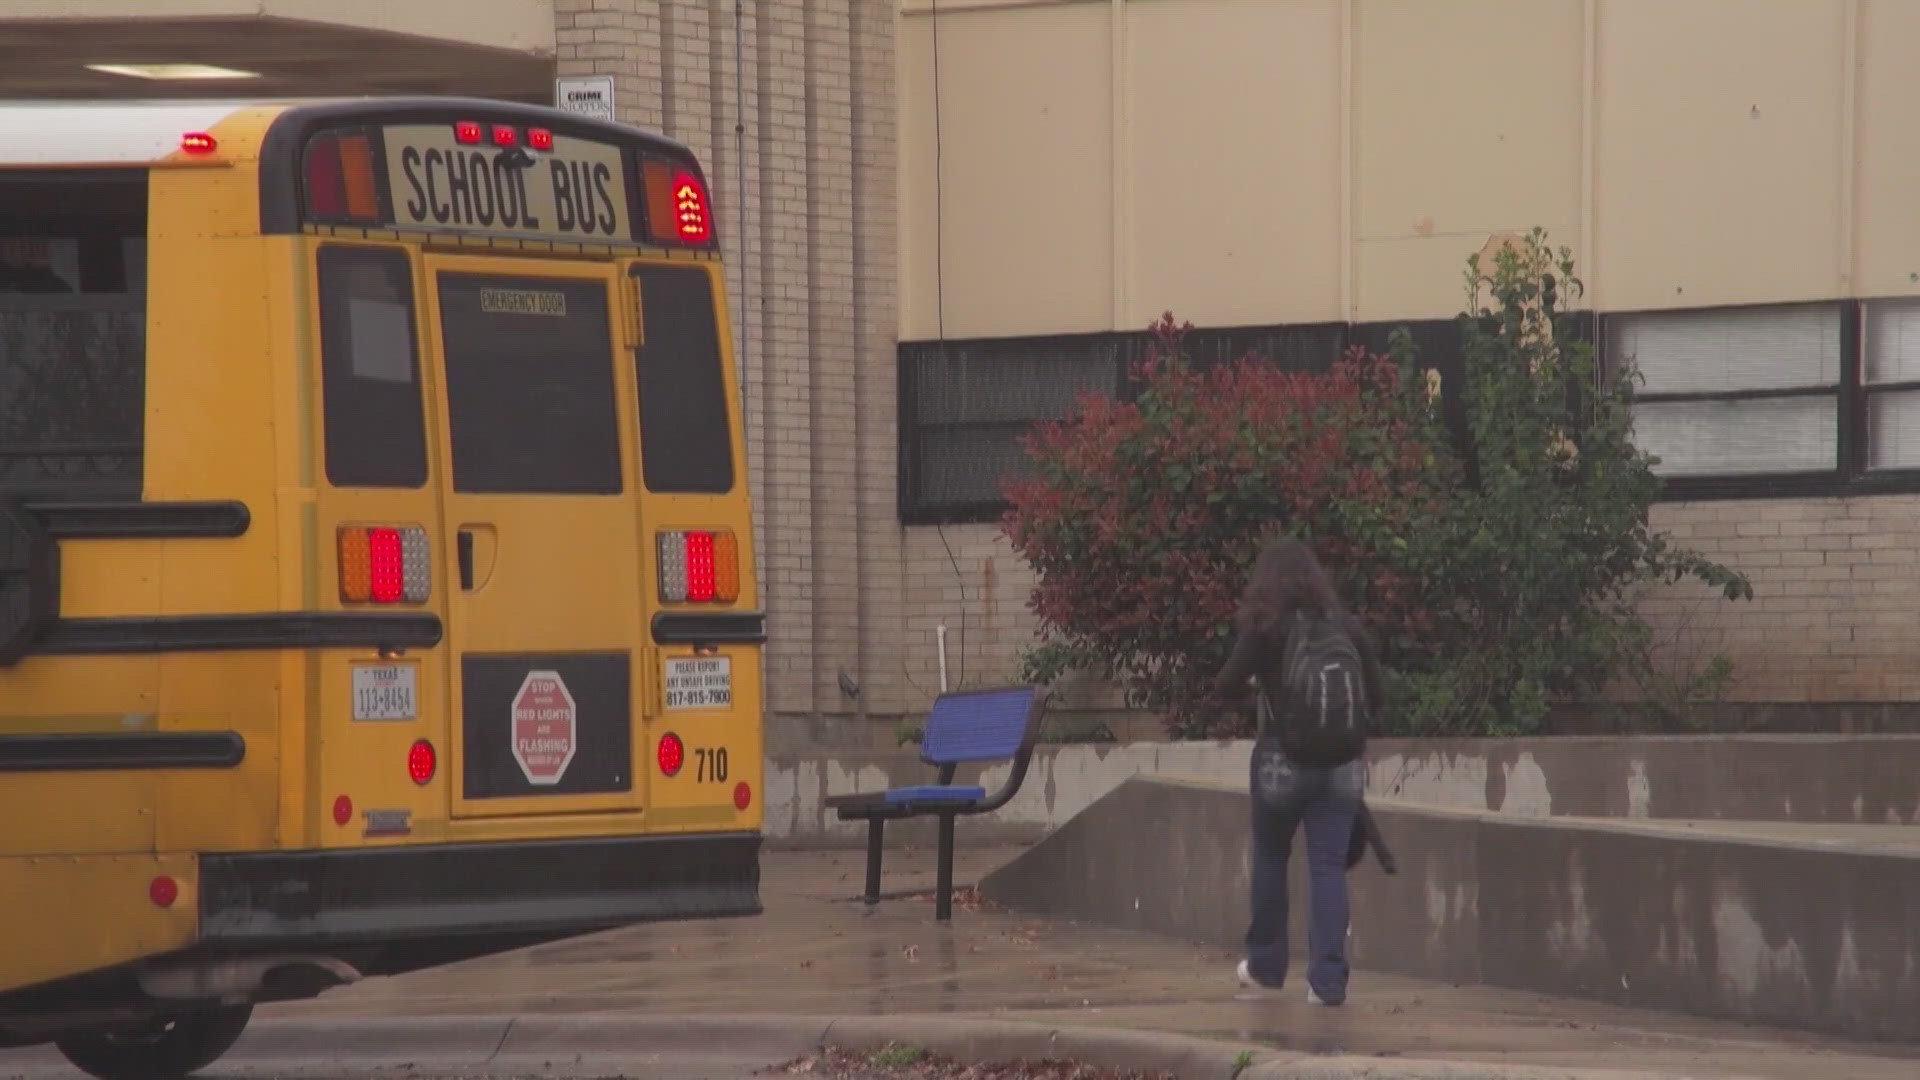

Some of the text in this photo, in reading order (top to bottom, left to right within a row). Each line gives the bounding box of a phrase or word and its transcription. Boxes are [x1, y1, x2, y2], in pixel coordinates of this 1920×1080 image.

[567, 91, 601, 102] CRIME
[402, 145, 616, 235] SCHOOL BUS
[481, 290, 565, 314] EMERGENCY DOOR
[675, 660, 720, 673] PLEASE REPORT
[373, 667, 398, 680] TEXAS
[531, 680, 556, 693] STOP
[667, 674, 730, 688] ANY UNSAFE DRIVING
[517, 708, 570, 720] RED LIGHTS
[537, 725, 551, 734] ARE
[520, 738, 568, 752] FLASHING
[695, 747, 728, 783] 710
